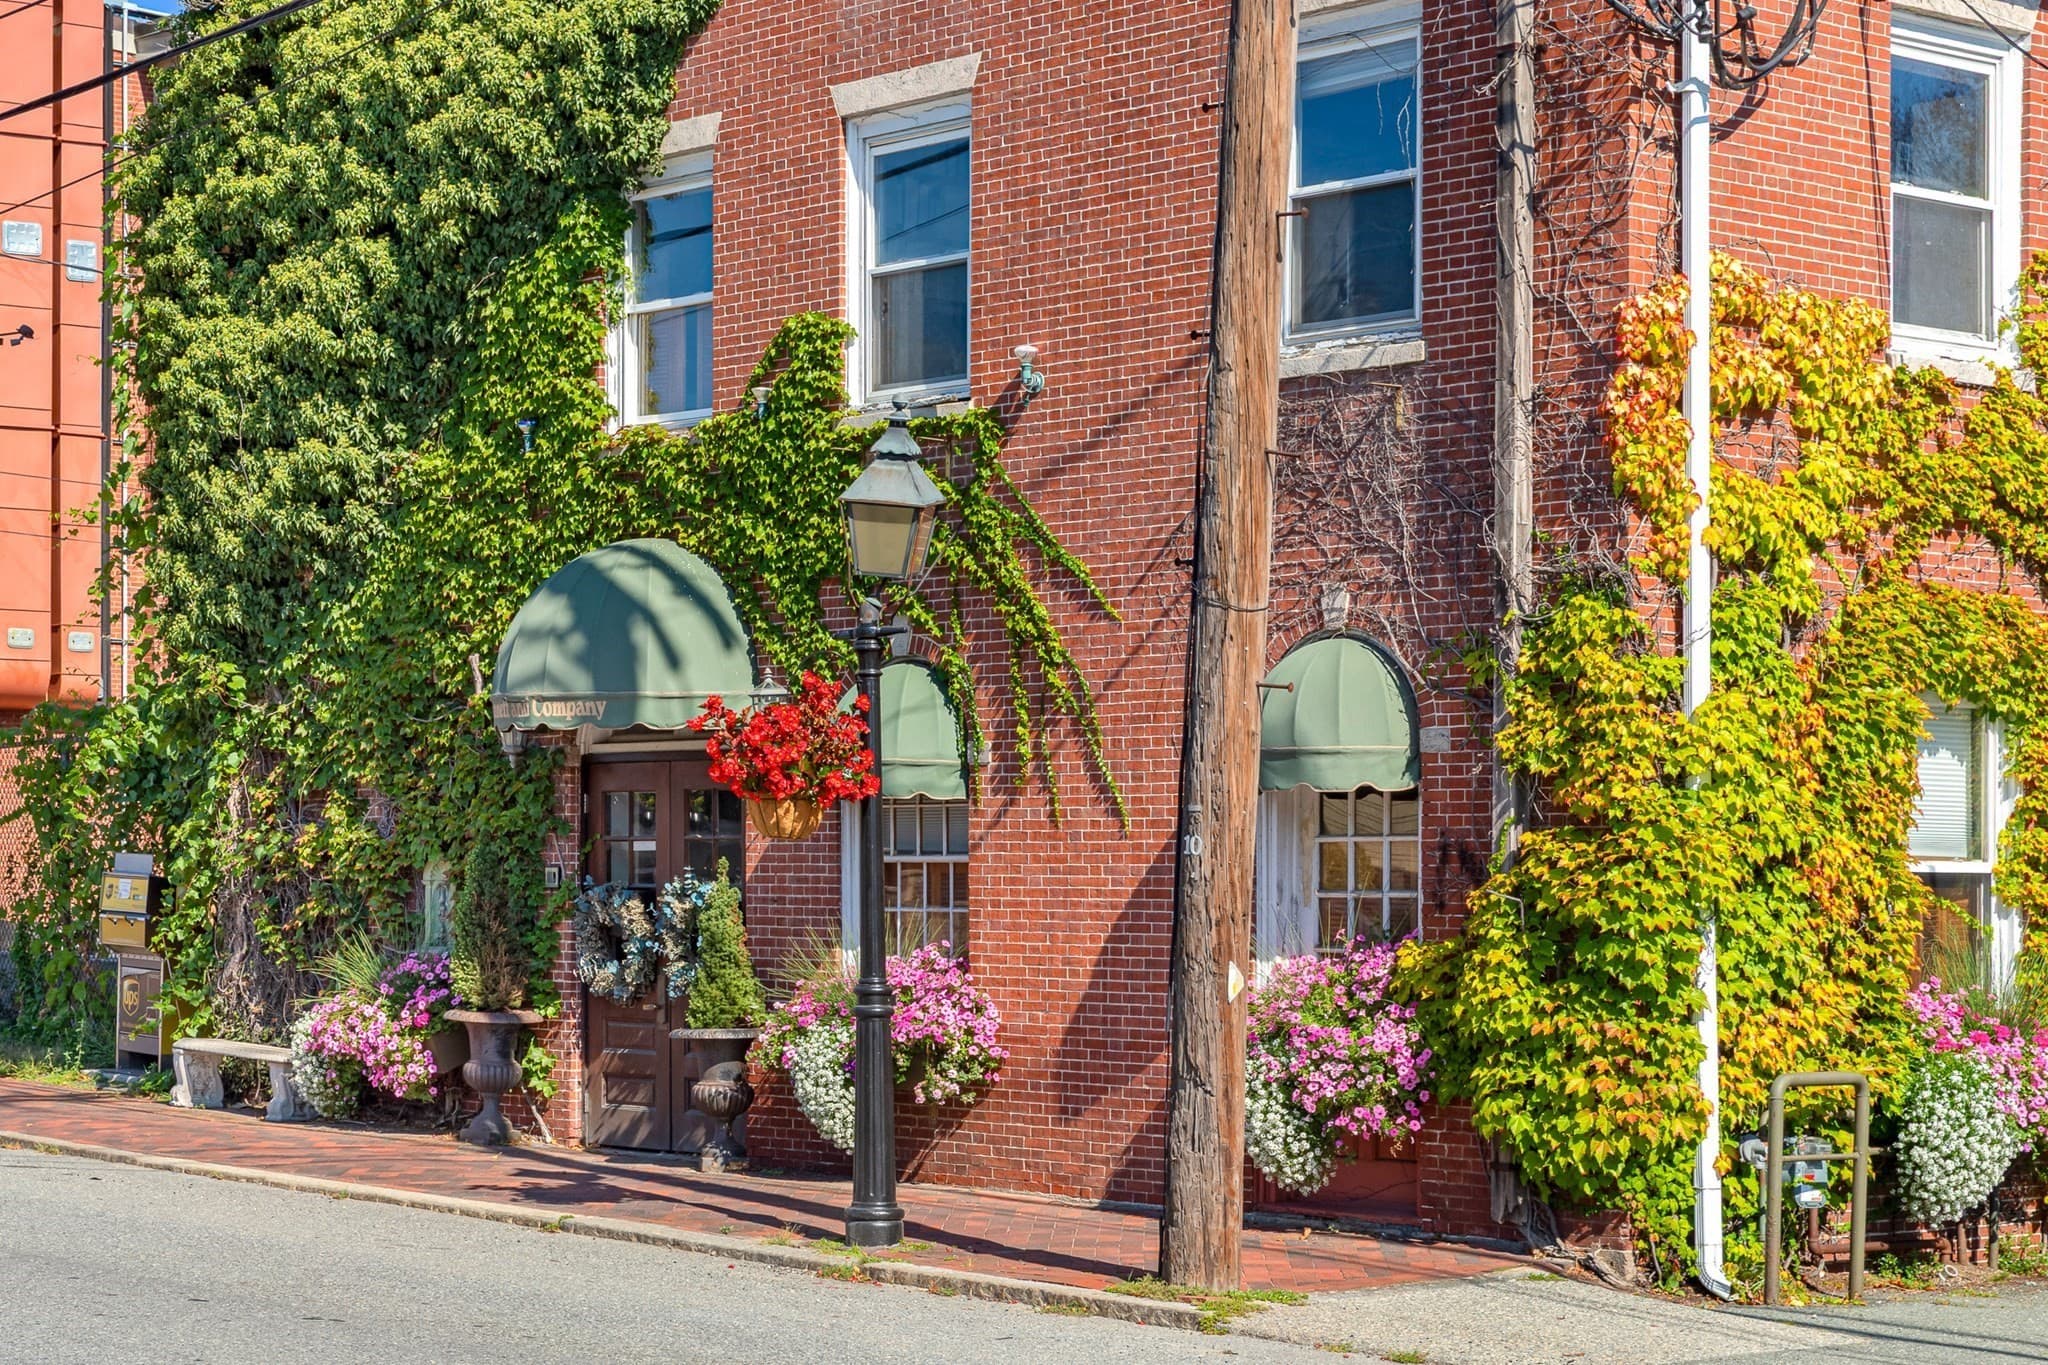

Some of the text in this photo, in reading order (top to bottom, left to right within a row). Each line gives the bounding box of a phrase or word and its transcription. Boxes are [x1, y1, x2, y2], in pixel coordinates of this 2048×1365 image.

[532, 699, 607, 720] Company
[1183, 834, 1202, 855] 10
[124, 991, 138, 1010] ups
